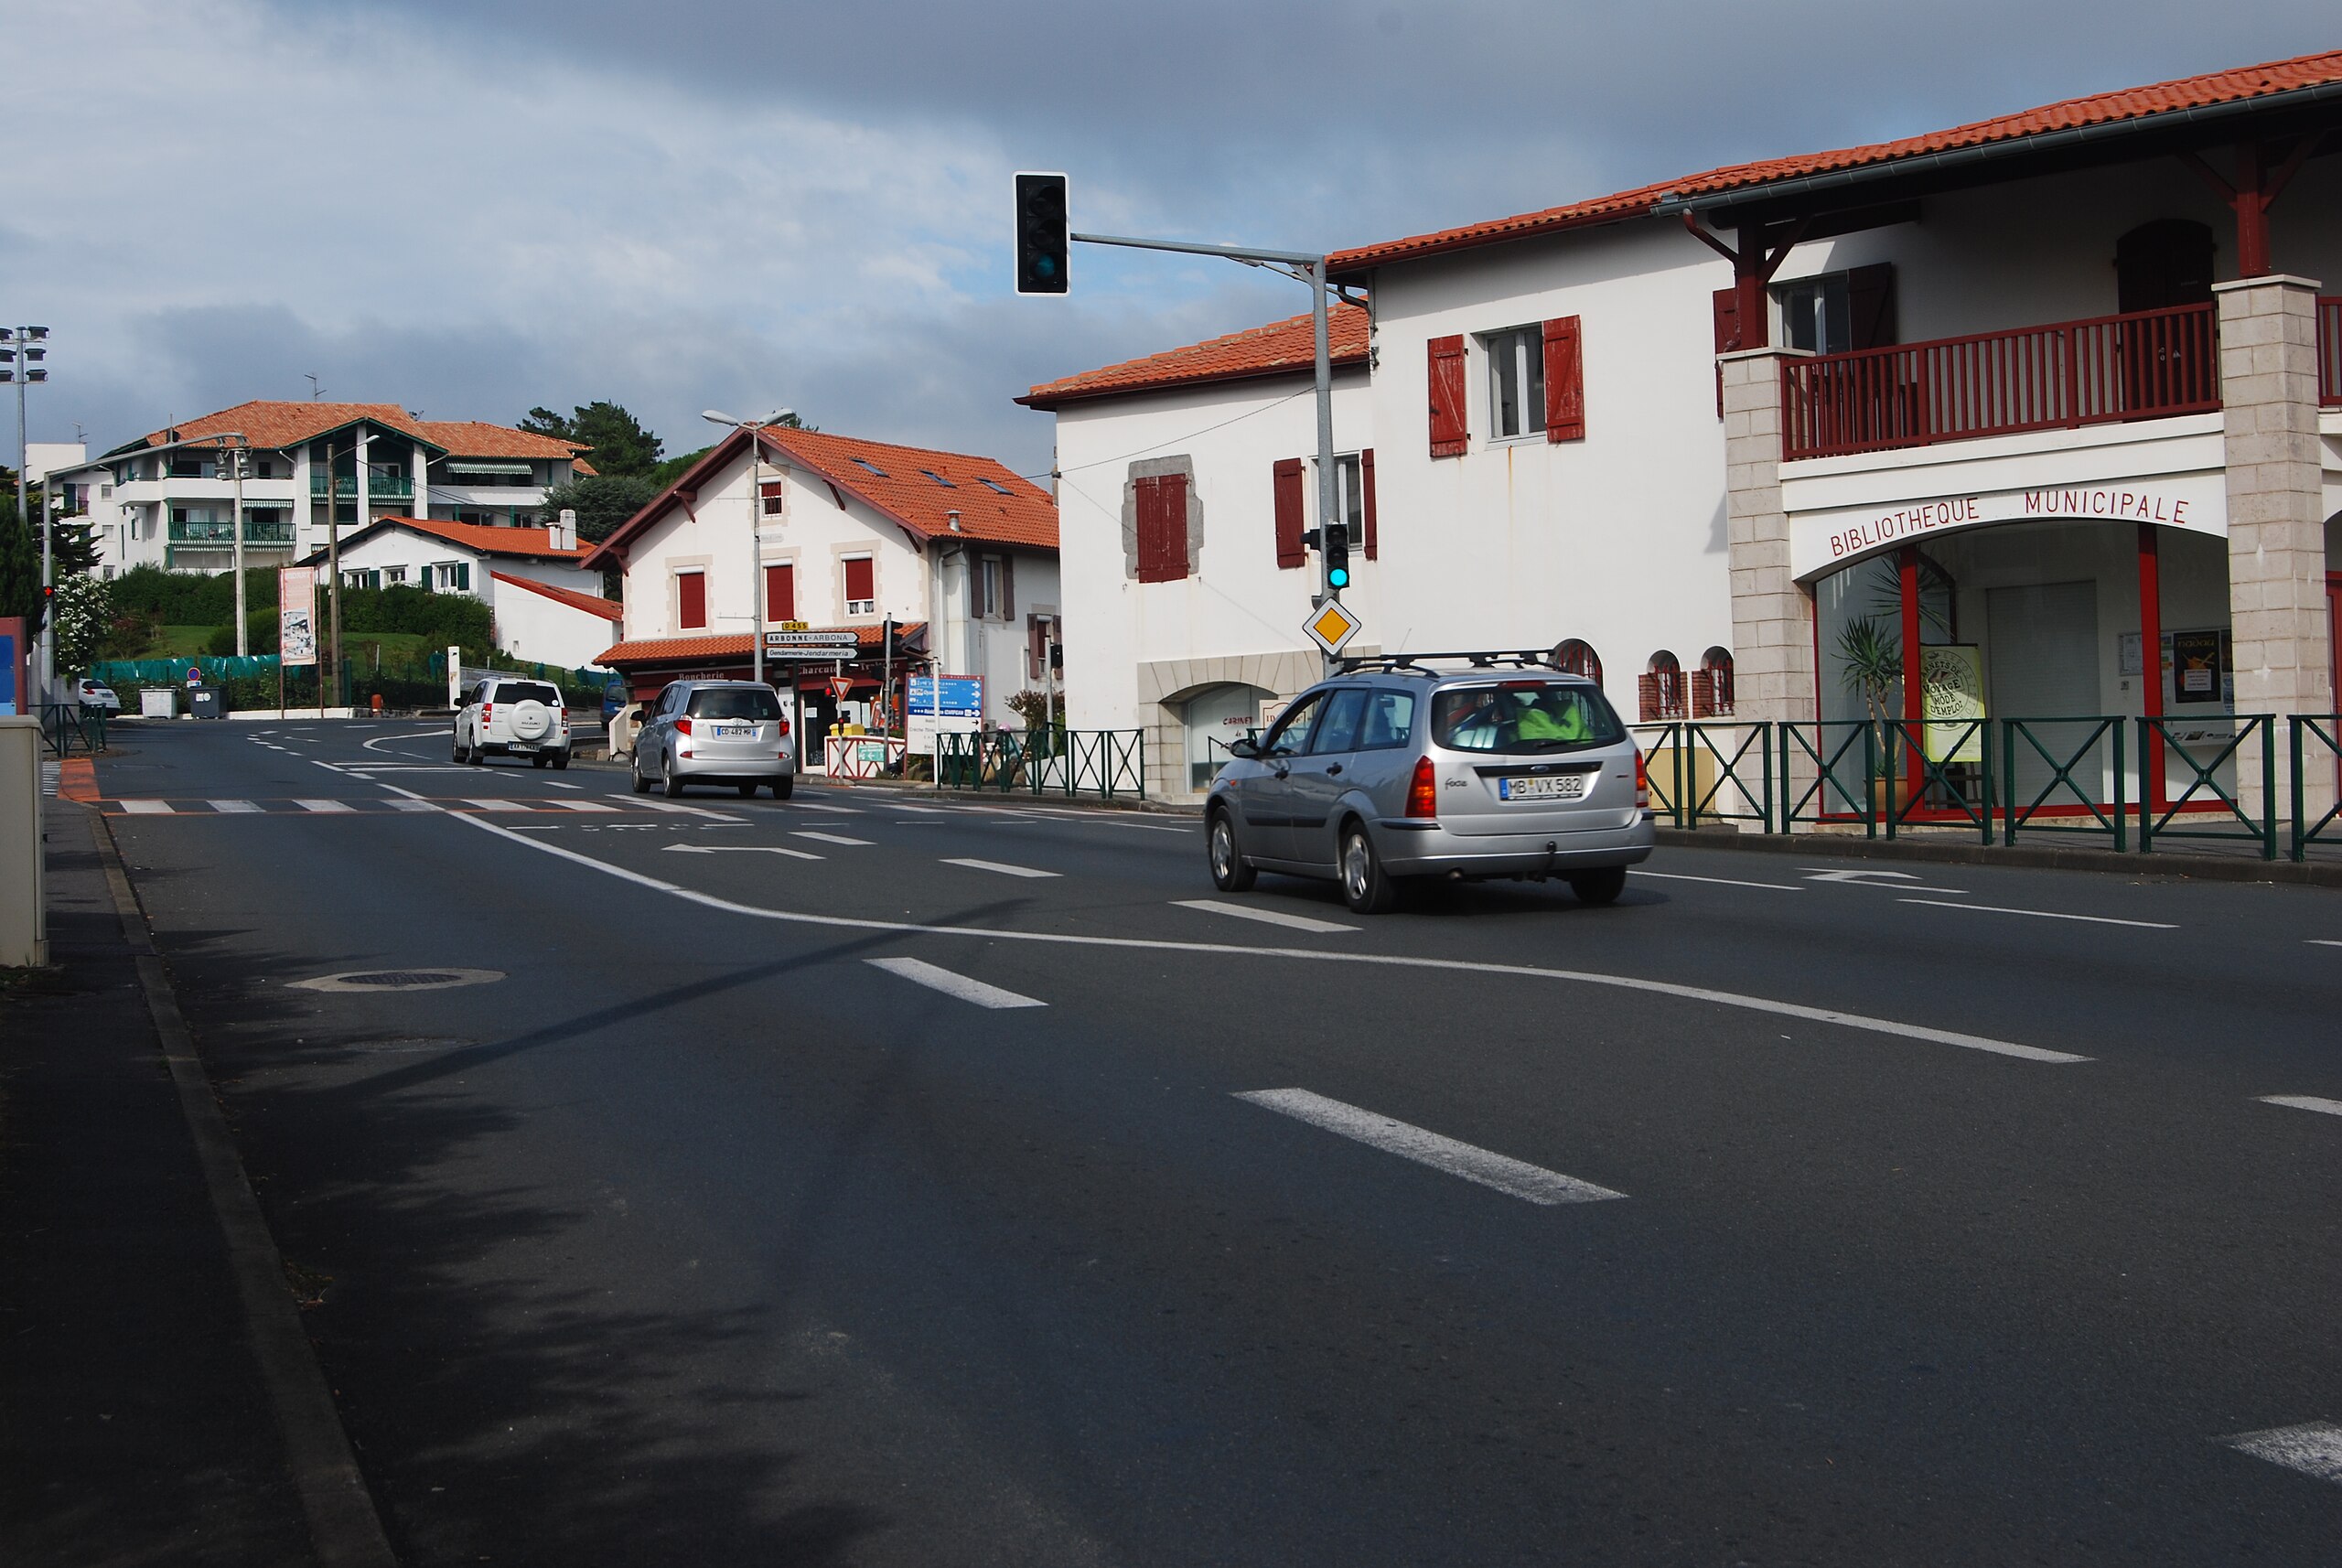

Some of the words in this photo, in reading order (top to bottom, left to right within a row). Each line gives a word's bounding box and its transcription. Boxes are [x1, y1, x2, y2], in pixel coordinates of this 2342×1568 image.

[1830, 497, 1980, 557] BIBLIOTHEQUE
[2025, 490, 2189, 524] MUNICIPALE
[679, 671, 725, 681] Boucherie
[1921, 660, 1950, 678] ARNETS
[1950, 665, 1961, 677] DE
[1922, 679, 1961, 694] VOYAGE
[1934, 693, 1956, 705] MODE
[1930, 700, 1963, 716] D'EMPLOI
[1222, 716, 1253, 725] CABINET
[1536, 778, 1553, 793] VX
[1556, 778, 1582, 792] 582
